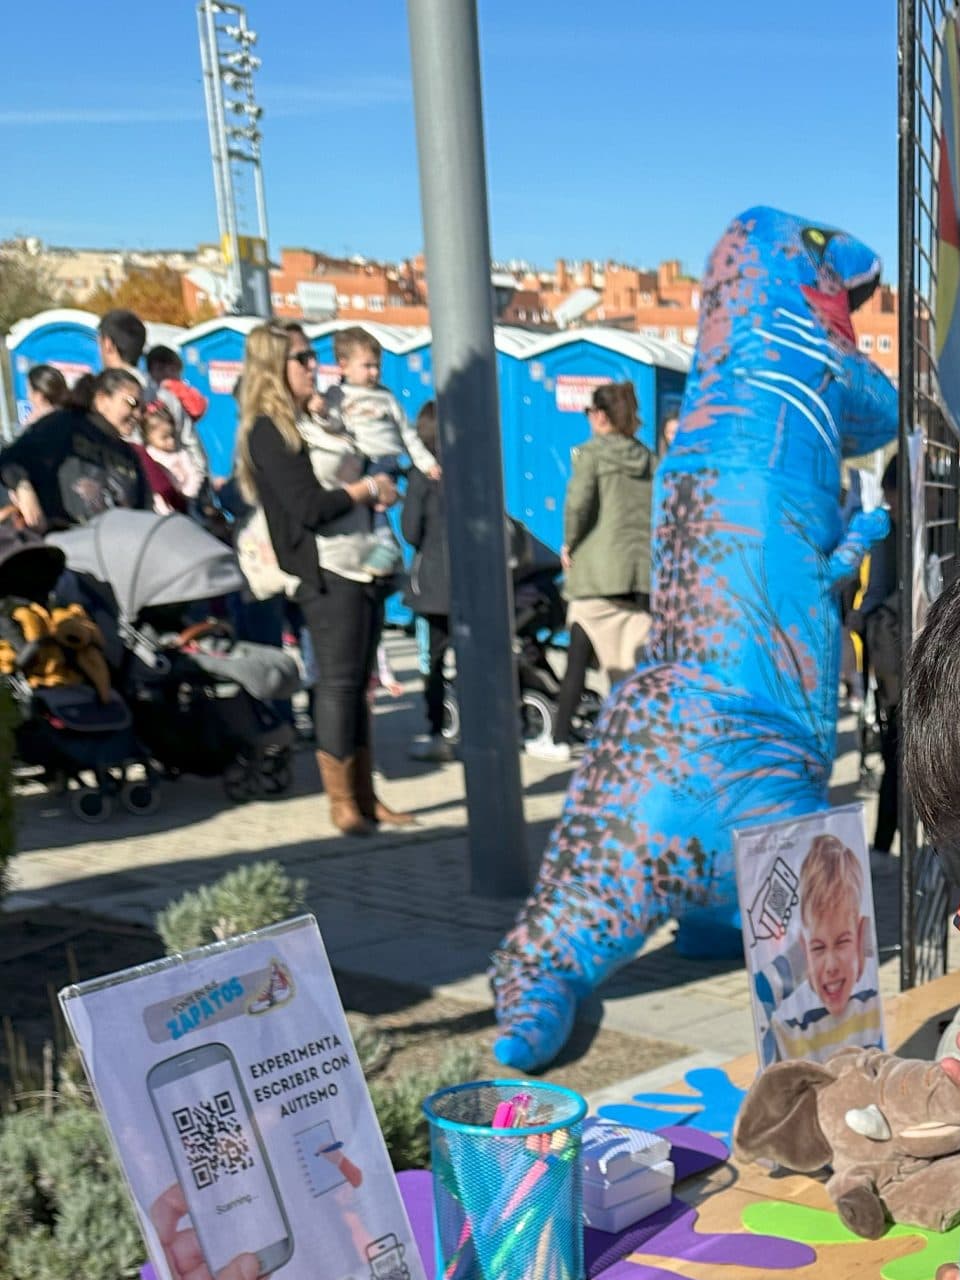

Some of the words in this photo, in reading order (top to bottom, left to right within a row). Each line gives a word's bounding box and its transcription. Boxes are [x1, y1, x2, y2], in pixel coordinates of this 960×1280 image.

[165, 976, 245, 1041] ZAPATOS
[249, 1034, 342, 1079] EXPERIMENTA
[254, 1067, 319, 1103] ESCRIBIR
[321, 1054, 350, 1076] CON
[280, 1083, 338, 1118] AUTISMO
